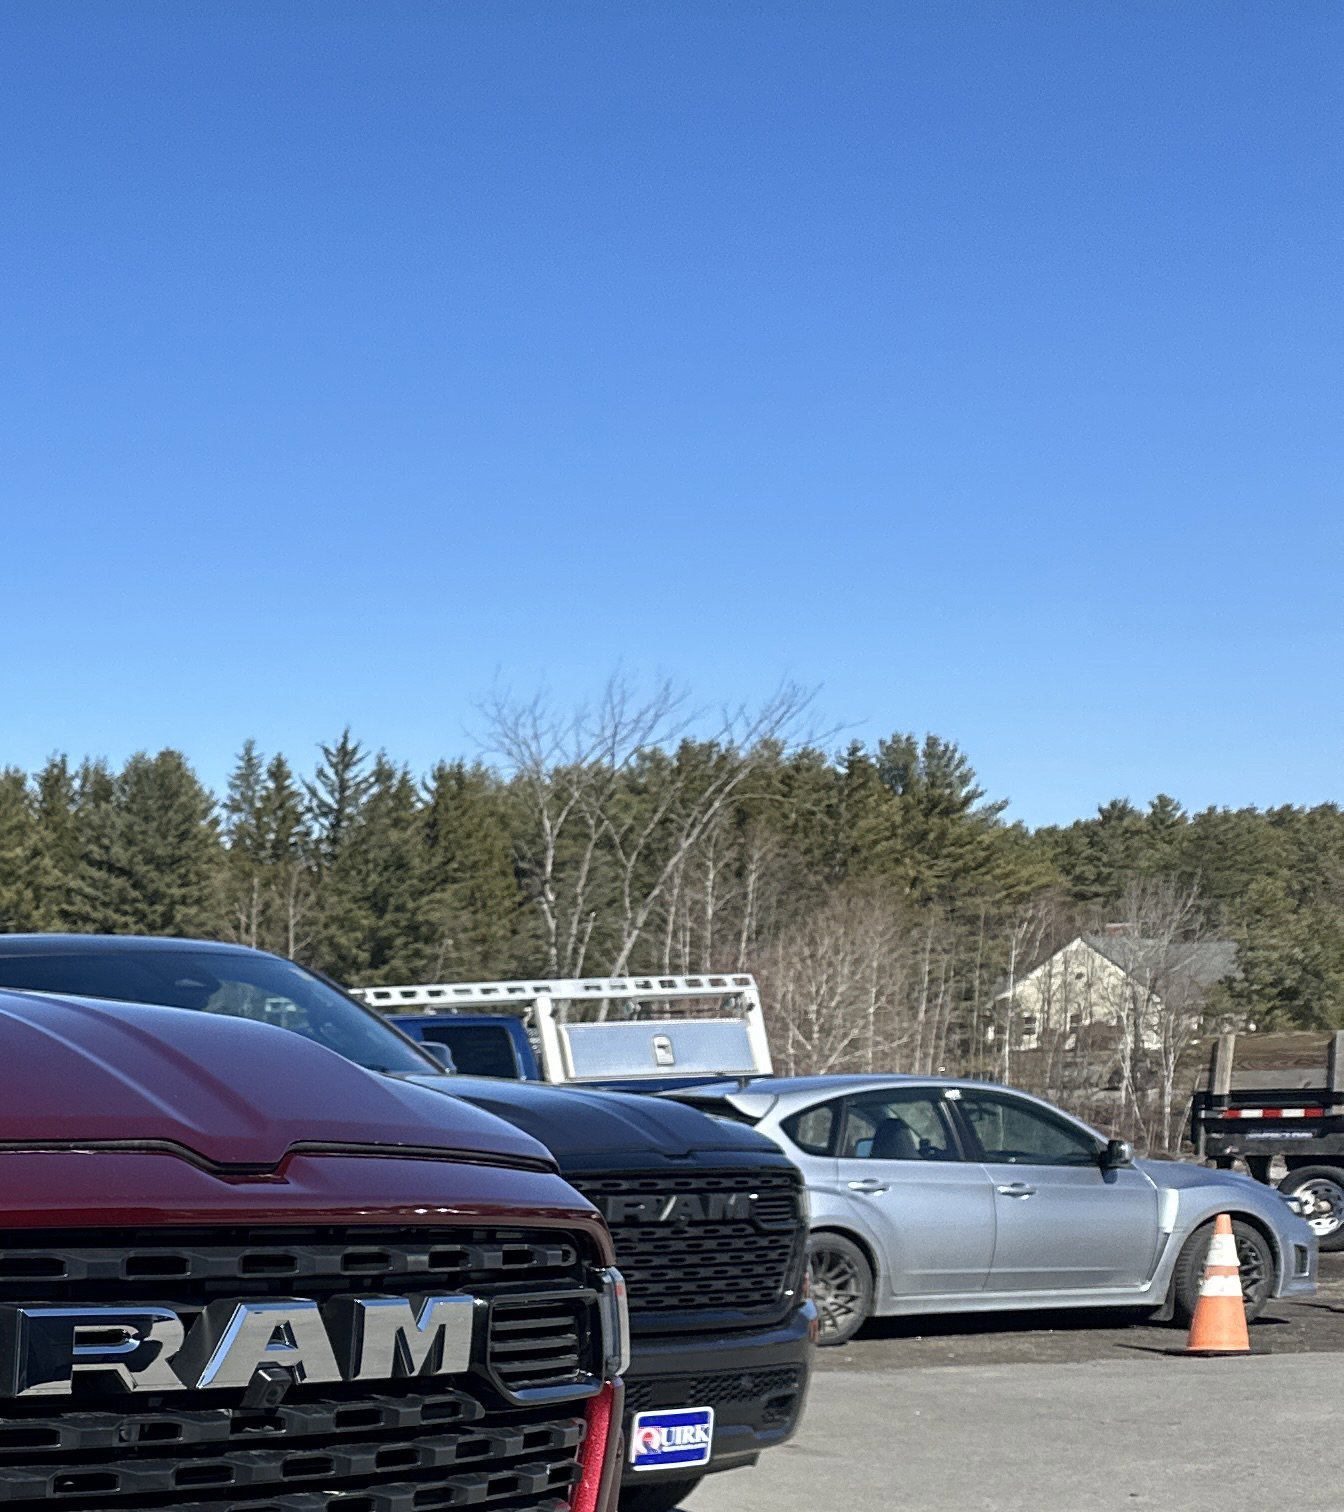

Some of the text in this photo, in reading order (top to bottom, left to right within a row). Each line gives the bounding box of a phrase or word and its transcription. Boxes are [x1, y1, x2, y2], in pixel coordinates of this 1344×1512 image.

[606, 1193, 750, 1222] RAM
[12, 1292, 475, 1397] RAM
[635, 1424, 710, 1456] QUIRK
